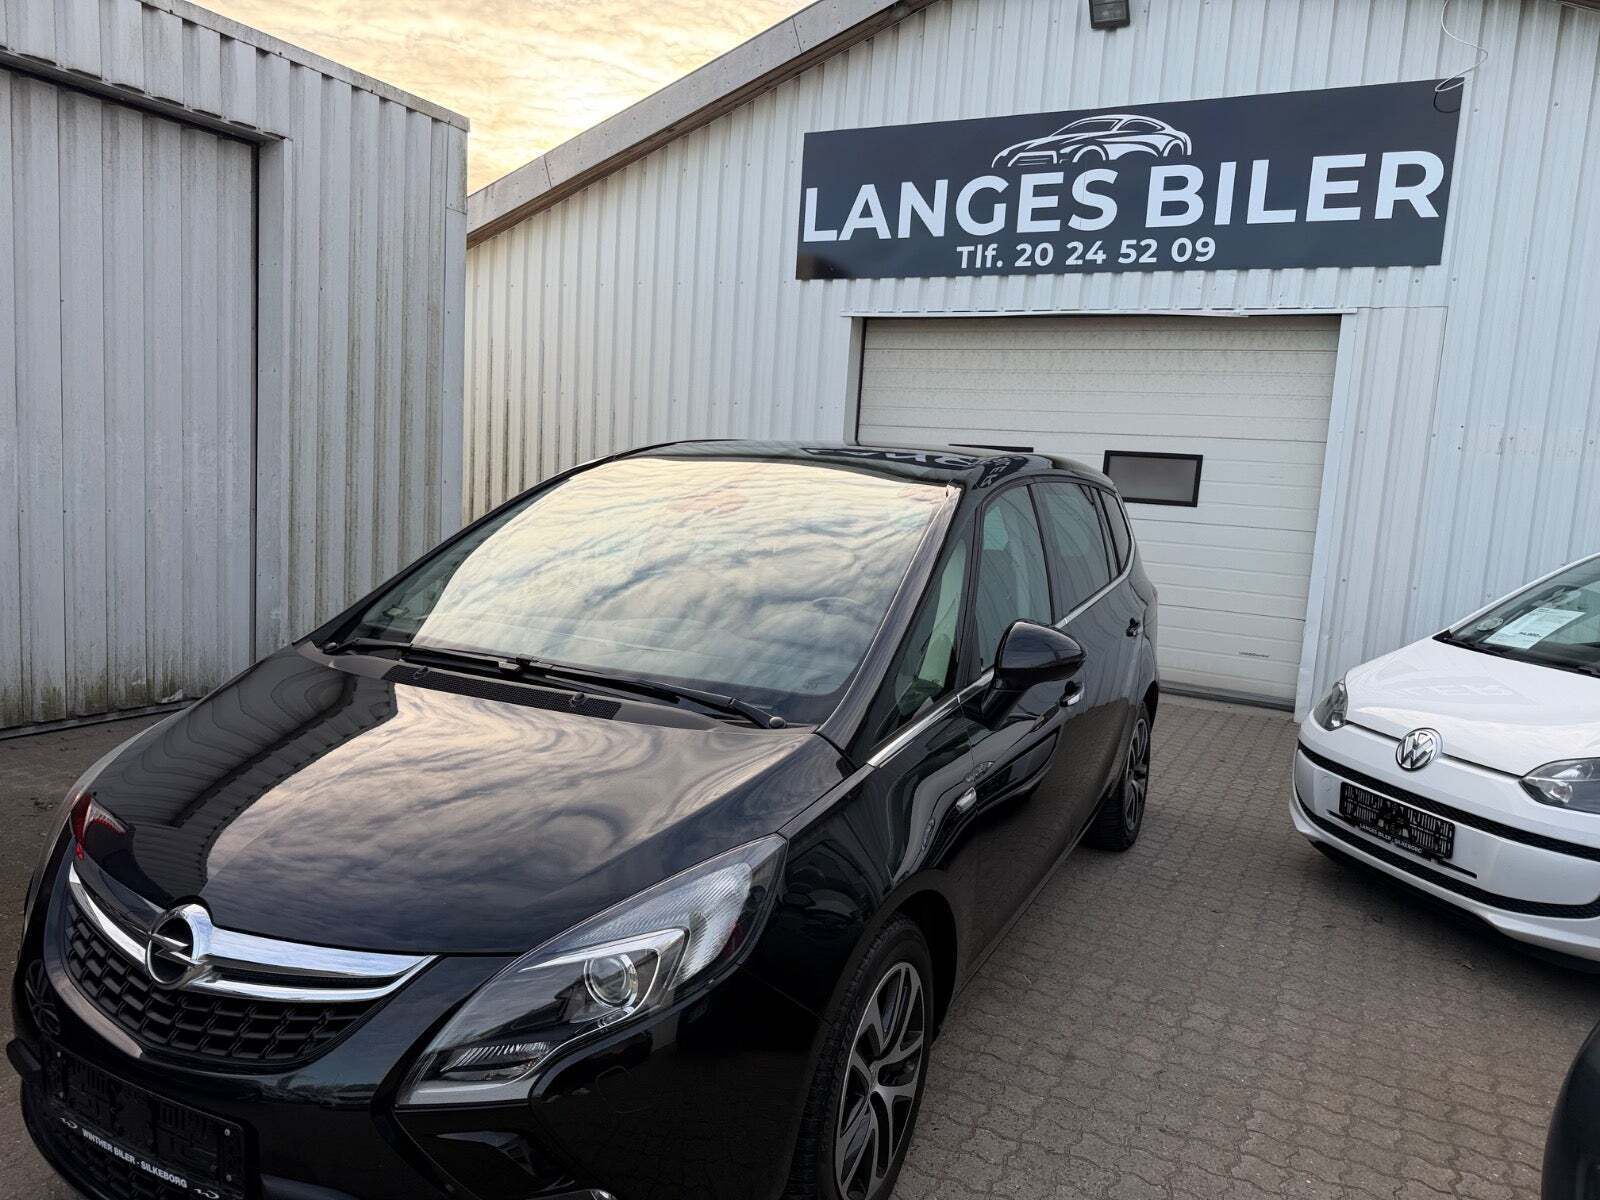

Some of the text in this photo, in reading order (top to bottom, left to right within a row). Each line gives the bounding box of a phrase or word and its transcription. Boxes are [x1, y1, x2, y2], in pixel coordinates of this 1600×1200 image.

[803, 149, 1443, 243] LANGES BILER
[956, 236, 1216, 269] Tlf. 20 24 52 09
[82, 1128, 113, 1152] WINTHER
[113, 1147, 136, 1165] BILER
[140, 1160, 188, 1188] SILKEBORG
